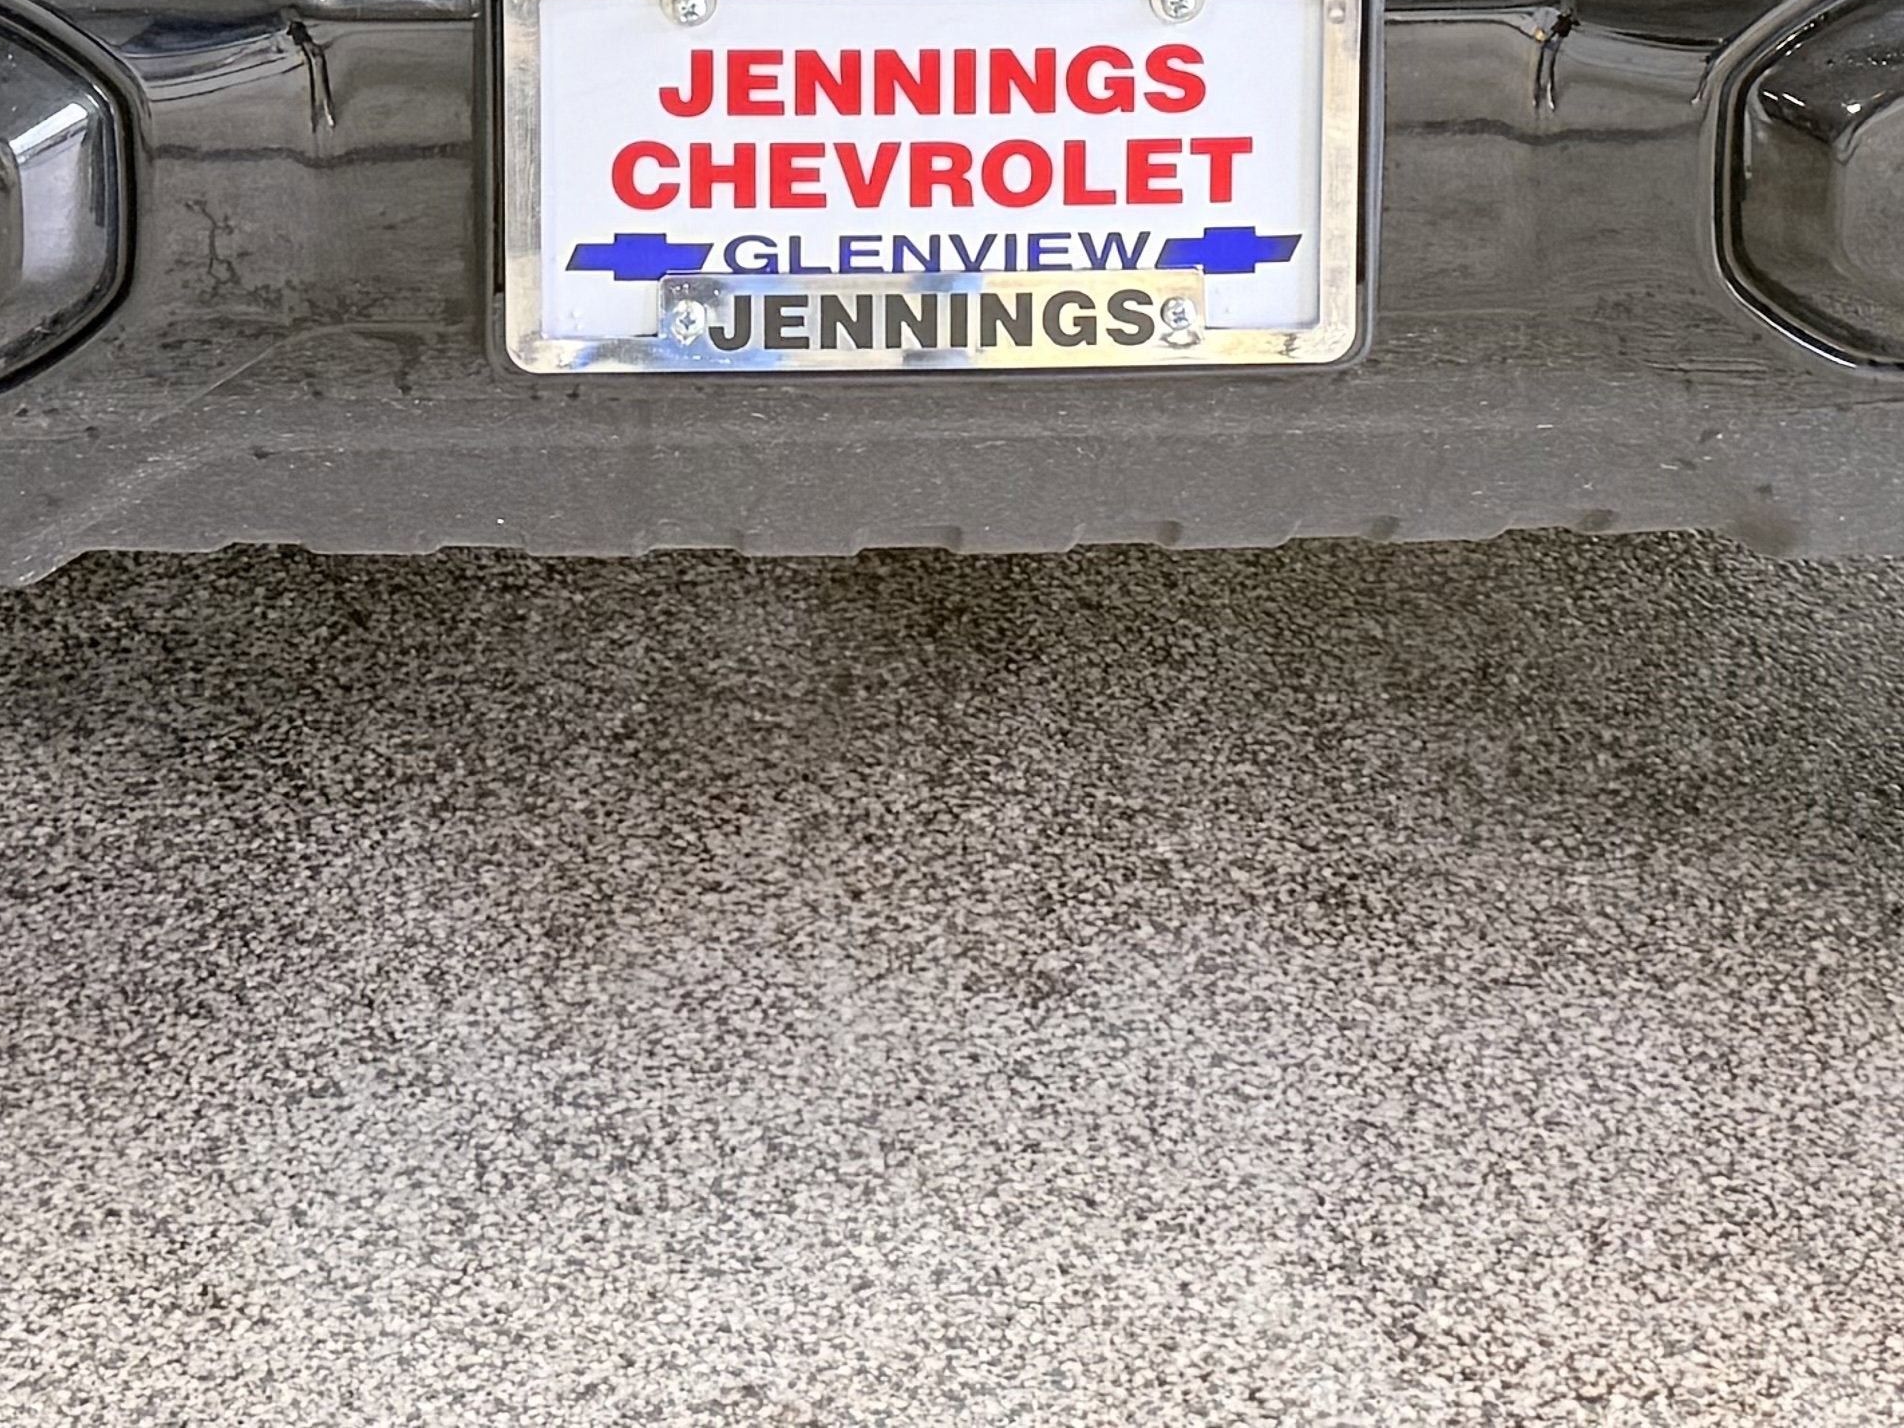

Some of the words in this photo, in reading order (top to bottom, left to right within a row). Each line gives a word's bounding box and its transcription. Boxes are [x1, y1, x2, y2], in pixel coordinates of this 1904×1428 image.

[658, 44, 1206, 118] JENNINGS
[610, 136, 1253, 211] CHEVROLET
[723, 230, 1152, 274] GLENVIEW
[708, 290, 1155, 351] JENNINGS
